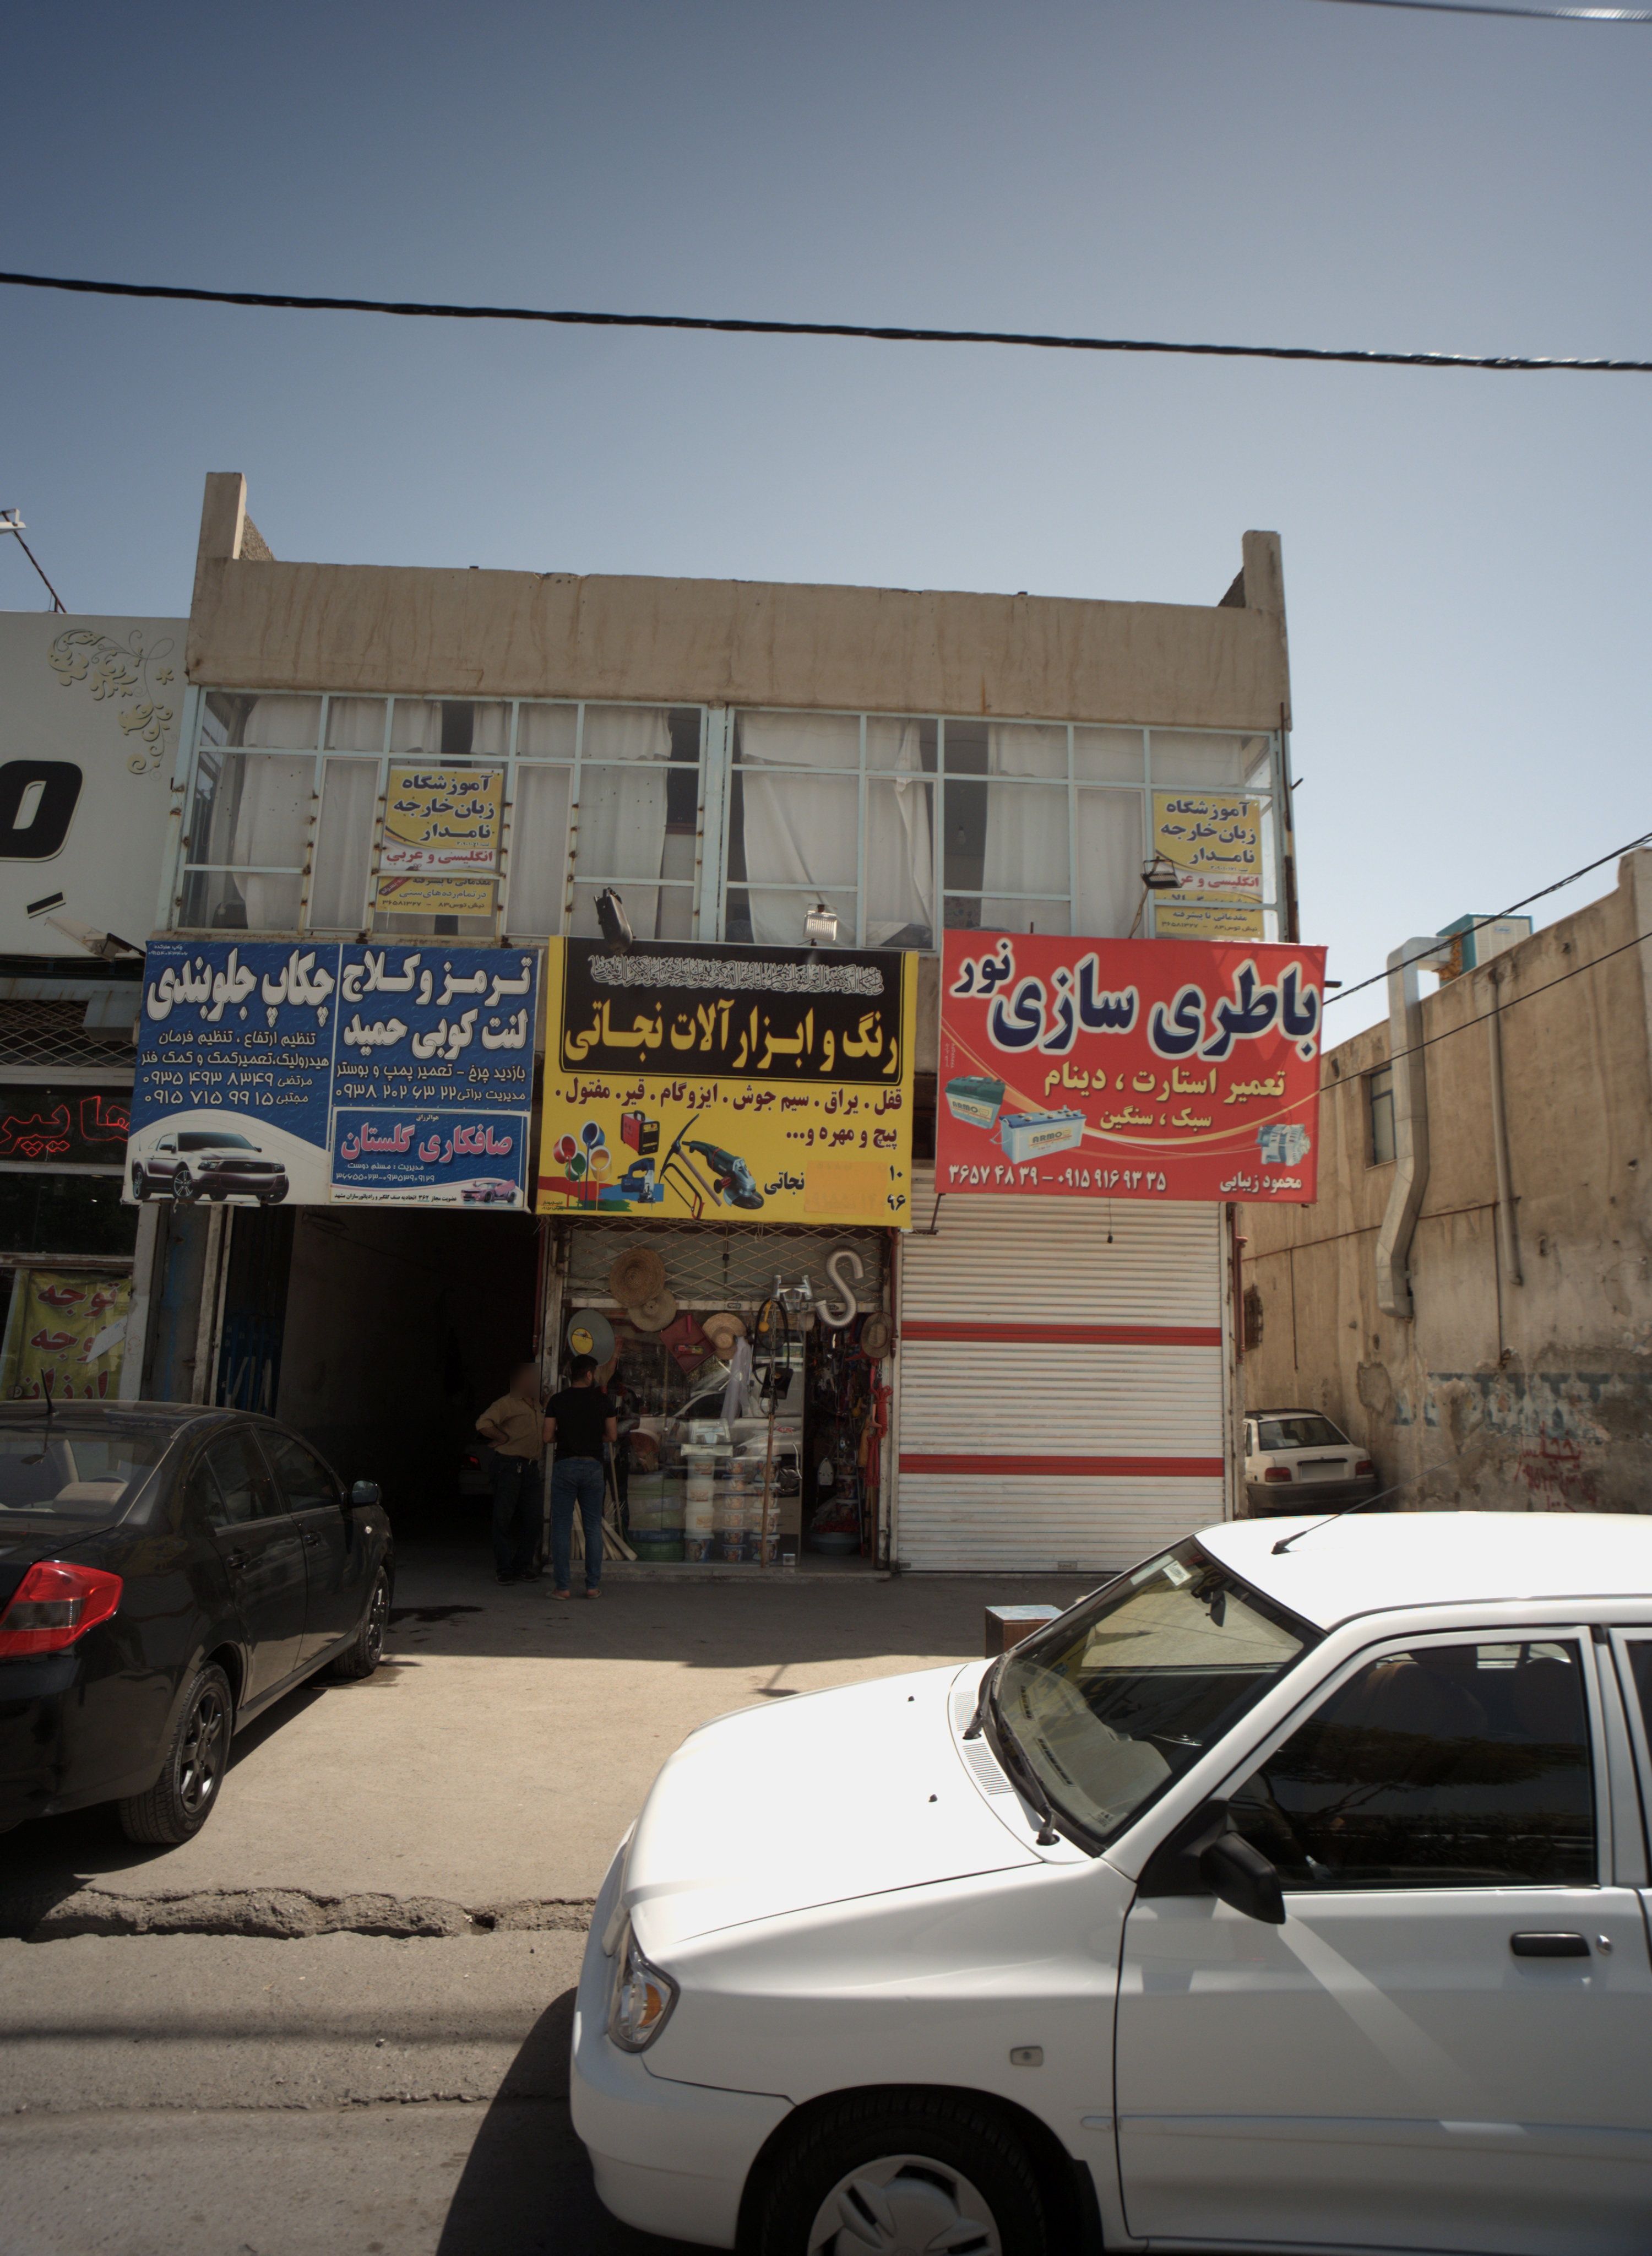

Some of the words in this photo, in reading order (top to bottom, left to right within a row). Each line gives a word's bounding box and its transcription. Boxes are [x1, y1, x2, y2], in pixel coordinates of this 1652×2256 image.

[402, 774, 493, 795] آموزشگاه
[394, 798, 454, 817] خارجه
[454, 799, 494, 819] زبان
[1166, 800, 1249, 821] آموزشگاه
[420, 823, 491, 841] نامدار
[1160, 822, 1218, 840] خارجه
[1218, 825, 1256, 844] زبان
[426, 854, 434, 863] و
[438, 851, 493, 864] انگلیسی
[1189, 847, 1255, 865] نامدار
[1197, 877, 1204, 887] و
[1208, 876, 1259, 888] انگلیسی
[342, 950, 421, 1002] کلاج
[954, 942, 1012, 993] نور
[146, 947, 258, 1022] جلوبندی
[262, 949, 335, 1028] چکاپ
[416, 969, 433, 1005] و
[436, 957, 532, 1006] ترمز
[992, 957, 1134, 1049] سازی
[1153, 963, 1317, 1056] باطری
[159, 1030, 194, 1045] فرمان
[198, 1030, 233, 1046] تنظیم
[344, 1014, 408, 1056] حمید
[412, 1008, 479, 1060] کوبی
[482, 1008, 529, 1049] لنت
[565, 998, 663, 1062] نجاتی
[244, 1032, 277, 1048] ارتفاع
[281, 1032, 317, 1048] تنظیم
[843, 1010, 899, 1074] رنگ
[141, 1051, 158, 1066] فنر
[162, 1051, 193, 1064] کمک
[197, 1053, 203, 1066] و
[819, 1029, 835, 1071] و
[143, 1071, 183, 1085] ۰۹۳۵
[189, 1071, 222, 1086] ۴۹۳
[336, 1061, 368, 1078] بوستر
[373, 1065, 379, 1075] و
[383, 1065, 414, 1082] پمپ
[417, 1064, 453, 1080] تعمیر
[468, 1064, 490, 1083] چرخ
[493, 1065, 526, 1083] بازدید
[1045, 1061, 1107, 1097] دینام
[227, 1072, 274, 1087] ۸۳۴۹
[277, 1076, 313, 1088] مرتضی
[1133, 1066, 1217, 1102] استارت
[1224, 1070, 1286, 1103] تعمیر
[144, 1089, 183, 1104] ۰۹۱۵
[189, 1090, 222, 1105] ۷۱۵
[276, 1094, 309, 1105] مجتبی
[335, 1083, 377, 1099] ۰۹۳۸
[383, 1084, 407, 1099] ۲۰۲
[413, 1086, 435, 1100] ۶۳
[486, 1089, 526, 1102] مدیریت
[566, 1076, 610, 1105] مفتول
[733, 1084, 776, 1111] جوش
[781, 1095, 809, 1112] سیم
[824, 1088, 858, 1115] یراق
[874, 1088, 902, 1115] قفل
[952, 1101, 979, 1113] ARMO
[1100, 1105, 1154, 1129] سنگین
[1171, 1107, 1212, 1132] سبک
[341, 1122, 416, 1160] گلستان
[419, 1124, 513, 1163] صافکاری
[819, 1126, 854, 1147] مهره
[858, 1130, 868, 1148] و
[873, 1127, 897, 1149] پیچ
[1032, 1131, 1063, 1143] ARMO
[398, 1163, 424, 1172] مدیریت
[764, 1172, 805, 1195] نجاتی
[949, 1164, 991, 1185] ۳۶۵۷
[995, 1165, 1014, 1185] ۴۸
[1019, 1165, 1038, 1186] ۳۹
[1057, 1167, 1090, 1189] ۰۹۱۵
[1094, 1168, 1120, 1189] ۹۱۶
[1123, 1169, 1142, 1190] ۹۳
[1146, 1171, 1167, 1191] ۳۵
[1220, 1171, 1259, 1192] زیبایی
[1263, 1175, 1302, 1193] محمود
[37, 1282, 121, 1318] توجه
